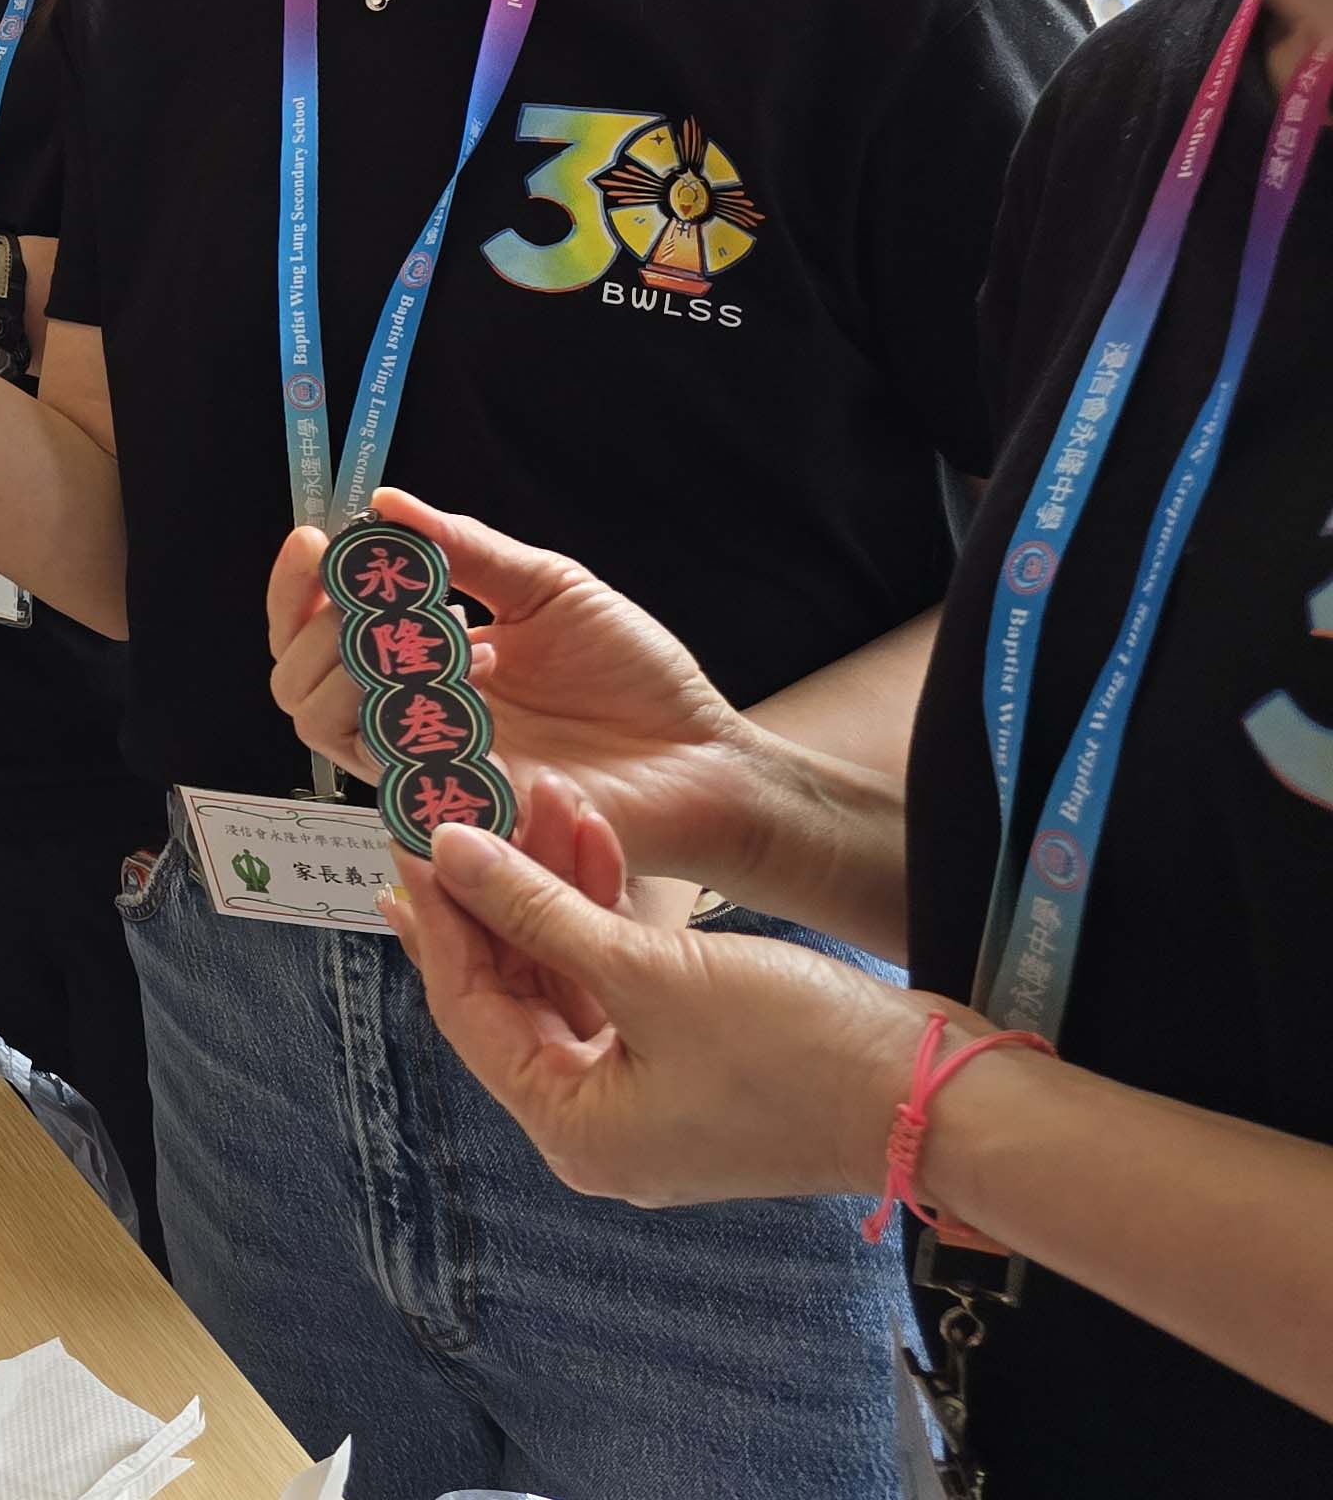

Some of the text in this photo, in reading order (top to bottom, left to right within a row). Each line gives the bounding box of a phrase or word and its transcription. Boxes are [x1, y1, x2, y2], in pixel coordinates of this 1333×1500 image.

[290, 97, 311, 366] Baptist Wing Lung Secondary School
[386, 294, 416, 349] Baptist
[601, 281, 744, 329] BWLSS
[370, 355, 399, 395] Wing
[360, 398, 388, 438] Lung
[342, 441, 377, 518] Secondary
[999, 608, 1029, 693] Baptist
[1059, 737, 1101, 824] Baptist
[1089, 672, 1126, 731] Wing
[1117, 603, 1150, 666] Lung
